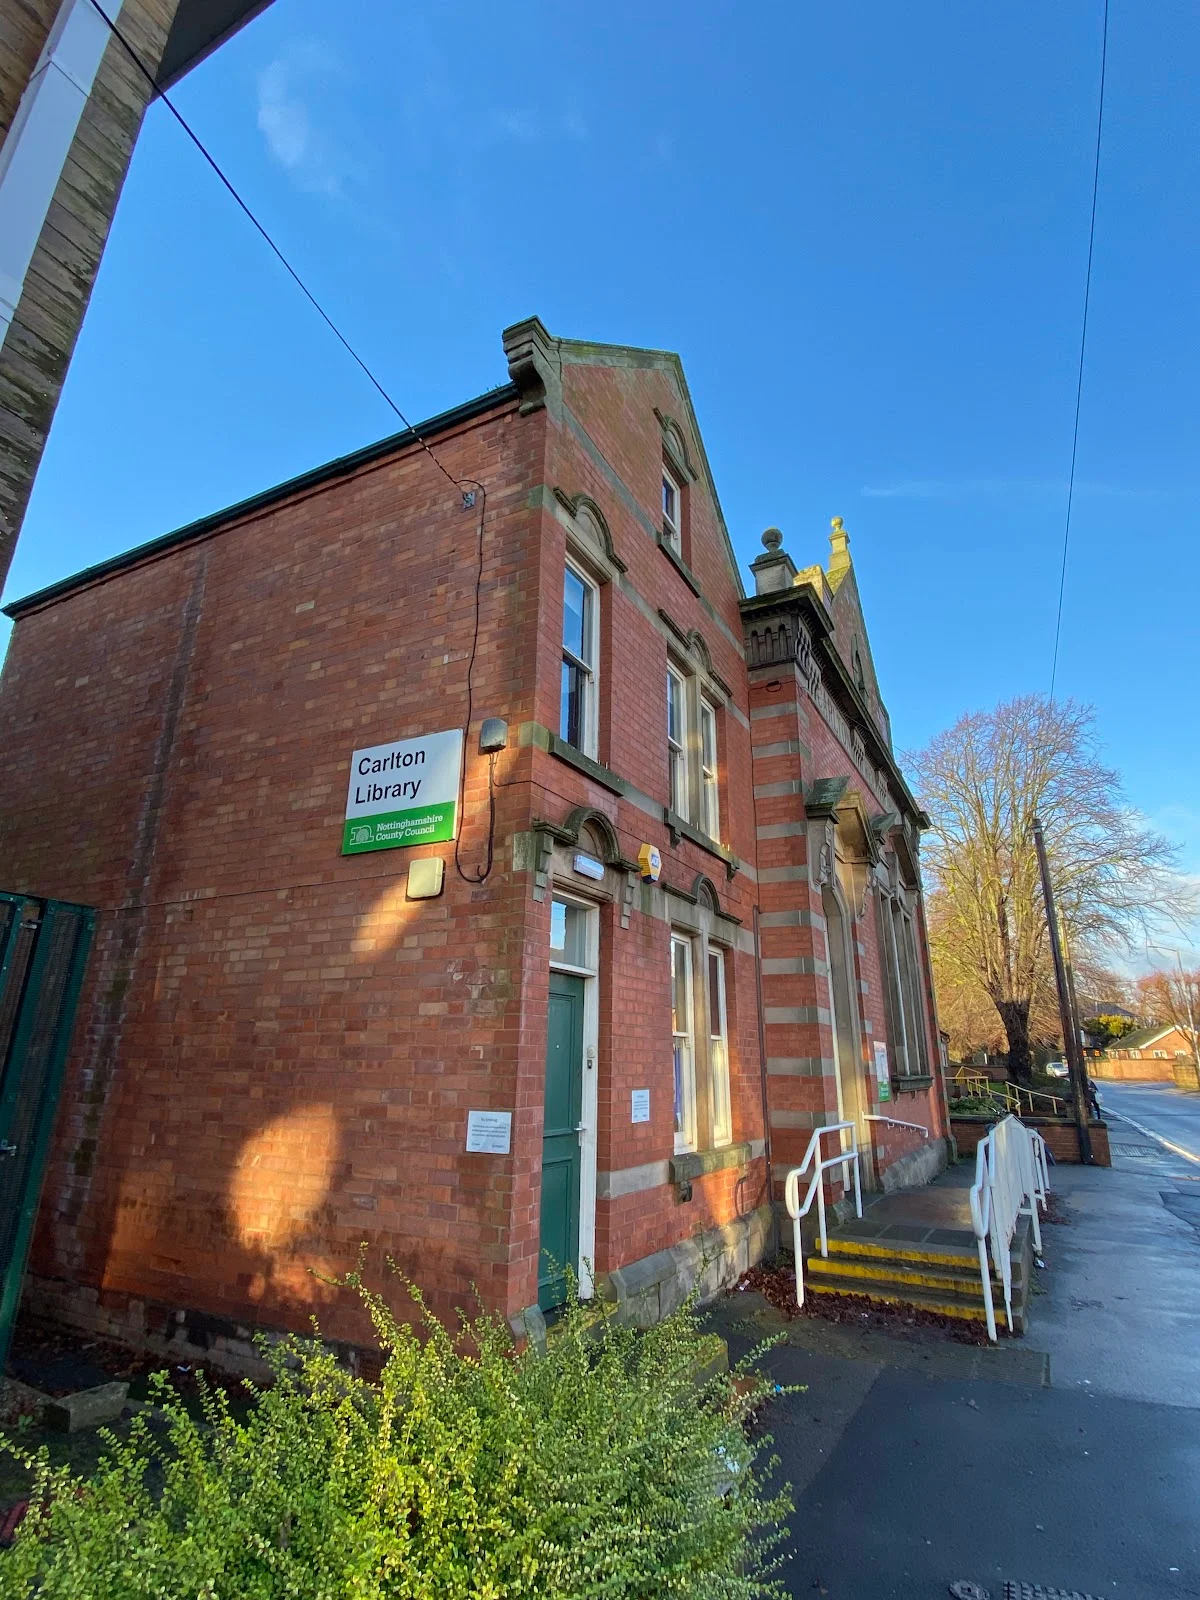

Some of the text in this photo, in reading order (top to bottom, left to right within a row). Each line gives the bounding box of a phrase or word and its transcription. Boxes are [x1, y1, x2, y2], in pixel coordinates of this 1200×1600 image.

[358, 750, 426, 776] Carlton
[355, 779, 422, 805] Library
[375, 824, 435, 842] County Council
[377, 815, 443, 831] Nottinghamshire
